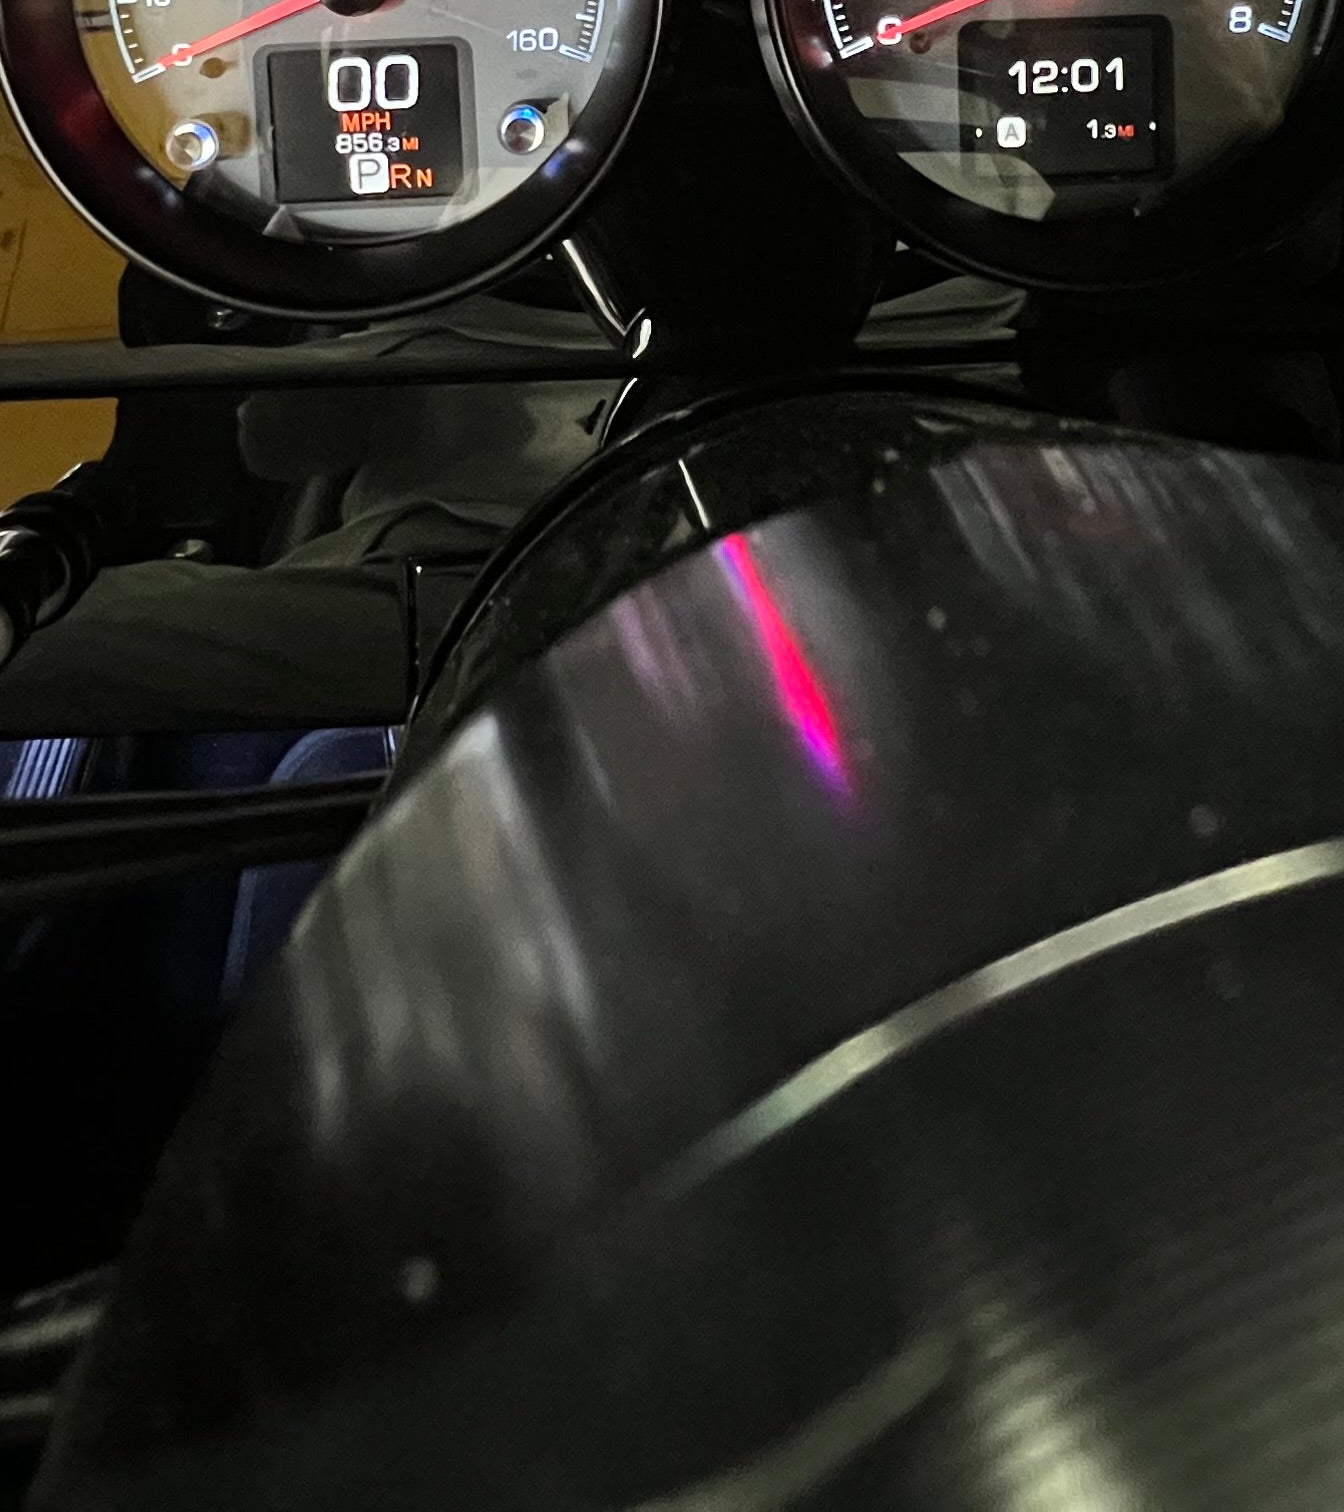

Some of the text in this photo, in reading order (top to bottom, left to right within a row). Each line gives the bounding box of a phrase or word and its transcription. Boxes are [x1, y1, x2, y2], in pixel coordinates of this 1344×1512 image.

[1229, 5, 1252, 33] 8
[507, 27, 559, 51] 160
[328, 54, 419, 112] 00
[1008, 56, 1124, 95] 12:01
[341, 111, 391, 132] MPH
[357, 158, 433, 189] P R N
